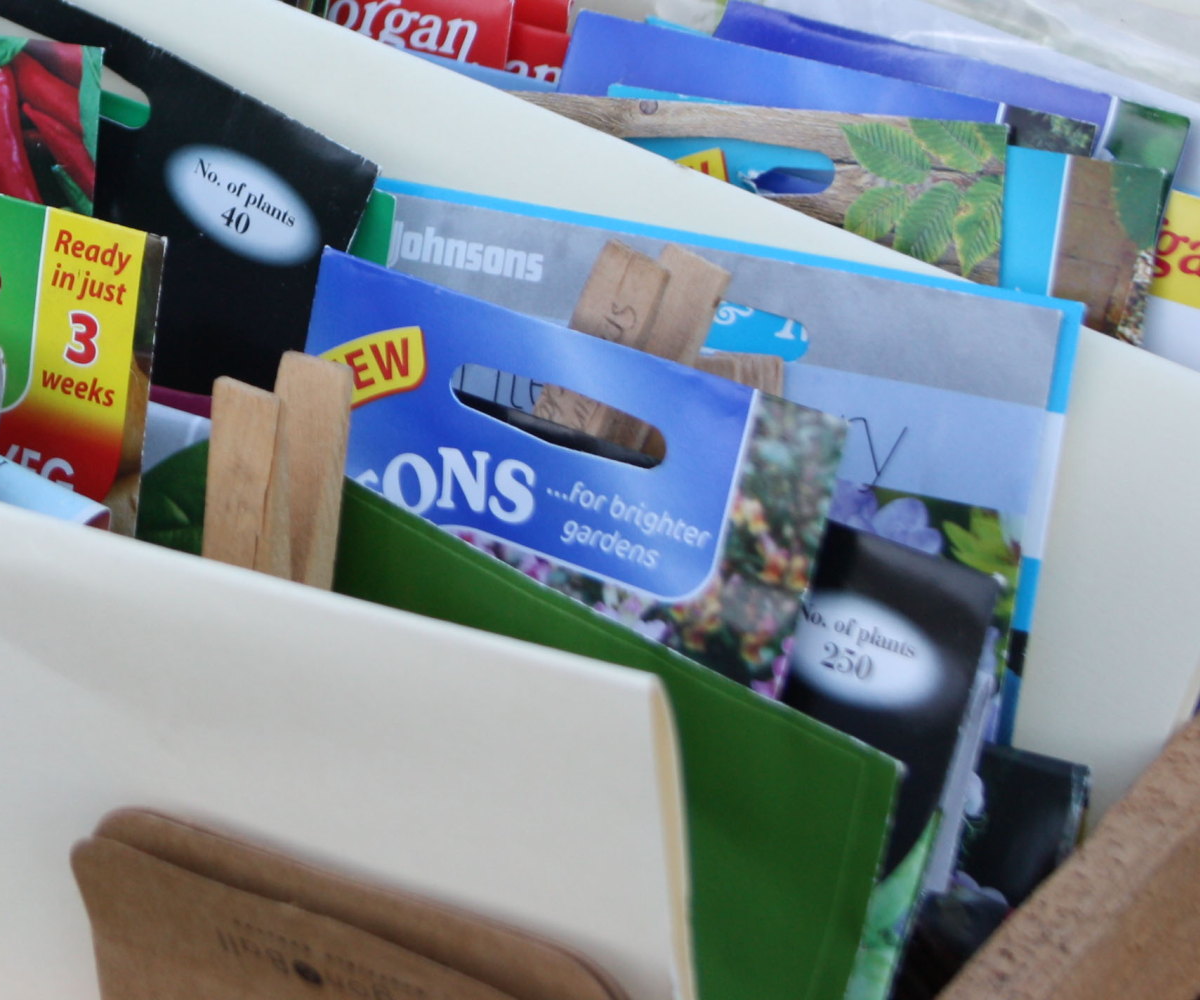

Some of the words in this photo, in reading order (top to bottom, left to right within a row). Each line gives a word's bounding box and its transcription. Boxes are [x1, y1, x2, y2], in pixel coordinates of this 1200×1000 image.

[194, 157, 221, 186] No.
[226, 182, 247, 197] of
[243, 192, 296, 229] plants
[220, 206, 251, 234] 40
[54, 229, 132, 276] Ready
[387, 220, 545, 282] Johnsons
[51, 263, 76, 291] in
[77, 270, 128, 305] just
[63, 309, 100, 367] 3
[41, 369, 116, 407] weeks
[560, 520, 661, 569] gardens
[609, 493, 713, 549] brighter
[821, 641, 874, 680] 250
[833, 618, 857, 637] of
[856, 626, 917, 659] plants
